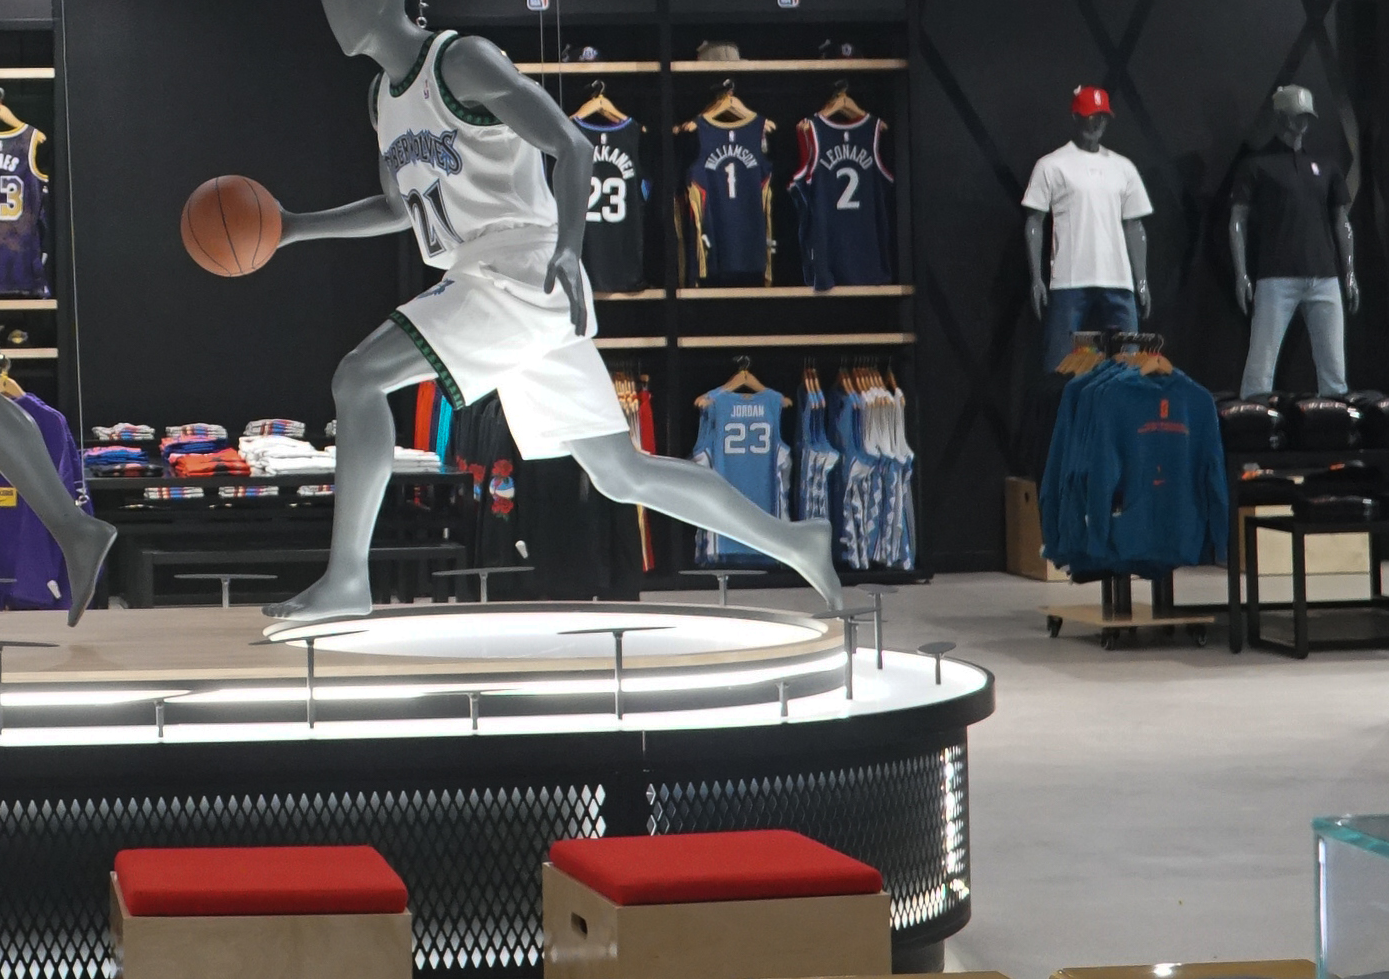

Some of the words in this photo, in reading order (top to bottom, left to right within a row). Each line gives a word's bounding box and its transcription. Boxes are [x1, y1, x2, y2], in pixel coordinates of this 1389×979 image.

[384, 128, 463, 176] BERWOLVES
[593, 145, 635, 180] KKANEN
[704, 144, 758, 171] WILLIAMSON
[820, 144, 873, 170] LEONARD
[724, 162, 737, 199] 1
[836, 167, 861, 210] 2
[585, 176, 627, 223] 23
[401, 178, 465, 258] 21
[731, 404, 765, 418] JORDAN
[724, 422, 771, 454] 23
